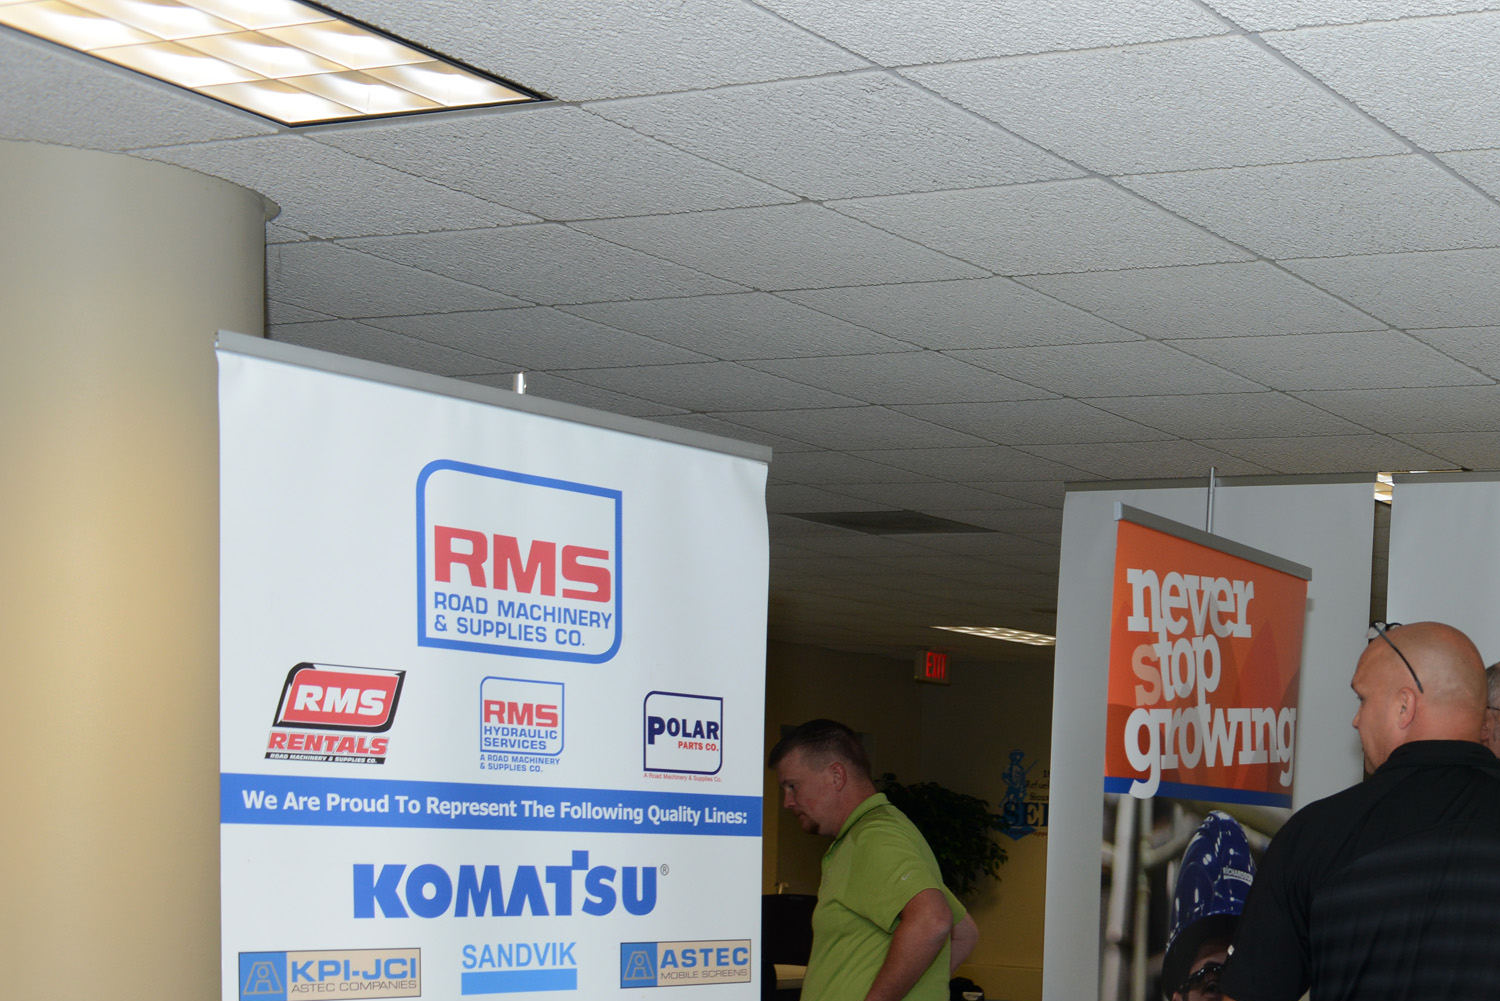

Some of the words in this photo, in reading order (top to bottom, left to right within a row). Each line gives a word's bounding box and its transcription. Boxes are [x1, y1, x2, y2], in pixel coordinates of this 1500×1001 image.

[434, 525, 611, 603] RMS
[434, 591, 488, 616] ROAD
[498, 598, 612, 630] MACHINERY
[1127, 568, 1254, 638] never
[434, 615, 448, 632] &
[457, 617, 548, 643] SUPPLIES
[556, 627, 585, 647] CO.
[926, 652, 947, 679] EXIT
[1132, 632, 1222, 712] stop
[294, 684, 387, 716] RMS
[484, 699, 558, 728] RMS
[268, 732, 389, 755] RENTALS
[484, 726, 558, 739] HYDRAULIC
[484, 737, 547, 750] SERVICES
[648, 716, 719, 745] POLAR
[290, 754, 327, 762] MACHINERY
[335, 756, 366, 764] SUPPLIES
[487, 754, 509, 763] ROAD
[511, 756, 560, 765] MACHINERY
[678, 741, 703, 751] PARTS
[705, 743, 719, 752] CO.
[1124, 706, 1297, 799] growing
[480, 762, 485, 770] &
[488, 763, 527, 772] SUPPLIES
[529, 765, 543, 773] CO.
[663, 773, 687, 782] Machinery
[693, 775, 713, 783] Supplies
[242, 790, 278, 810] We
[283, 792, 320, 811] Are
[326, 793, 389, 813] Proud
[395, 795, 421, 814] To
[426, 797, 517, 819] Represent
[521, 800, 555, 818] The
[560, 802, 643, 825] Following
[648, 805, 701, 827] Quality
[705, 807, 747, 825] Lines:
[353, 850, 657, 919] KOMATSU
[462, 942, 577, 970] SANDVIK
[660, 947, 749, 969] ASTEC
[291, 958, 417, 982] KPI-JCI
[660, 970, 699, 980] MOBILE
[702, 968, 748, 979] SCREENS
[291, 983, 335, 993] ASTEC
[339, 980, 417, 992] COMPANIES
